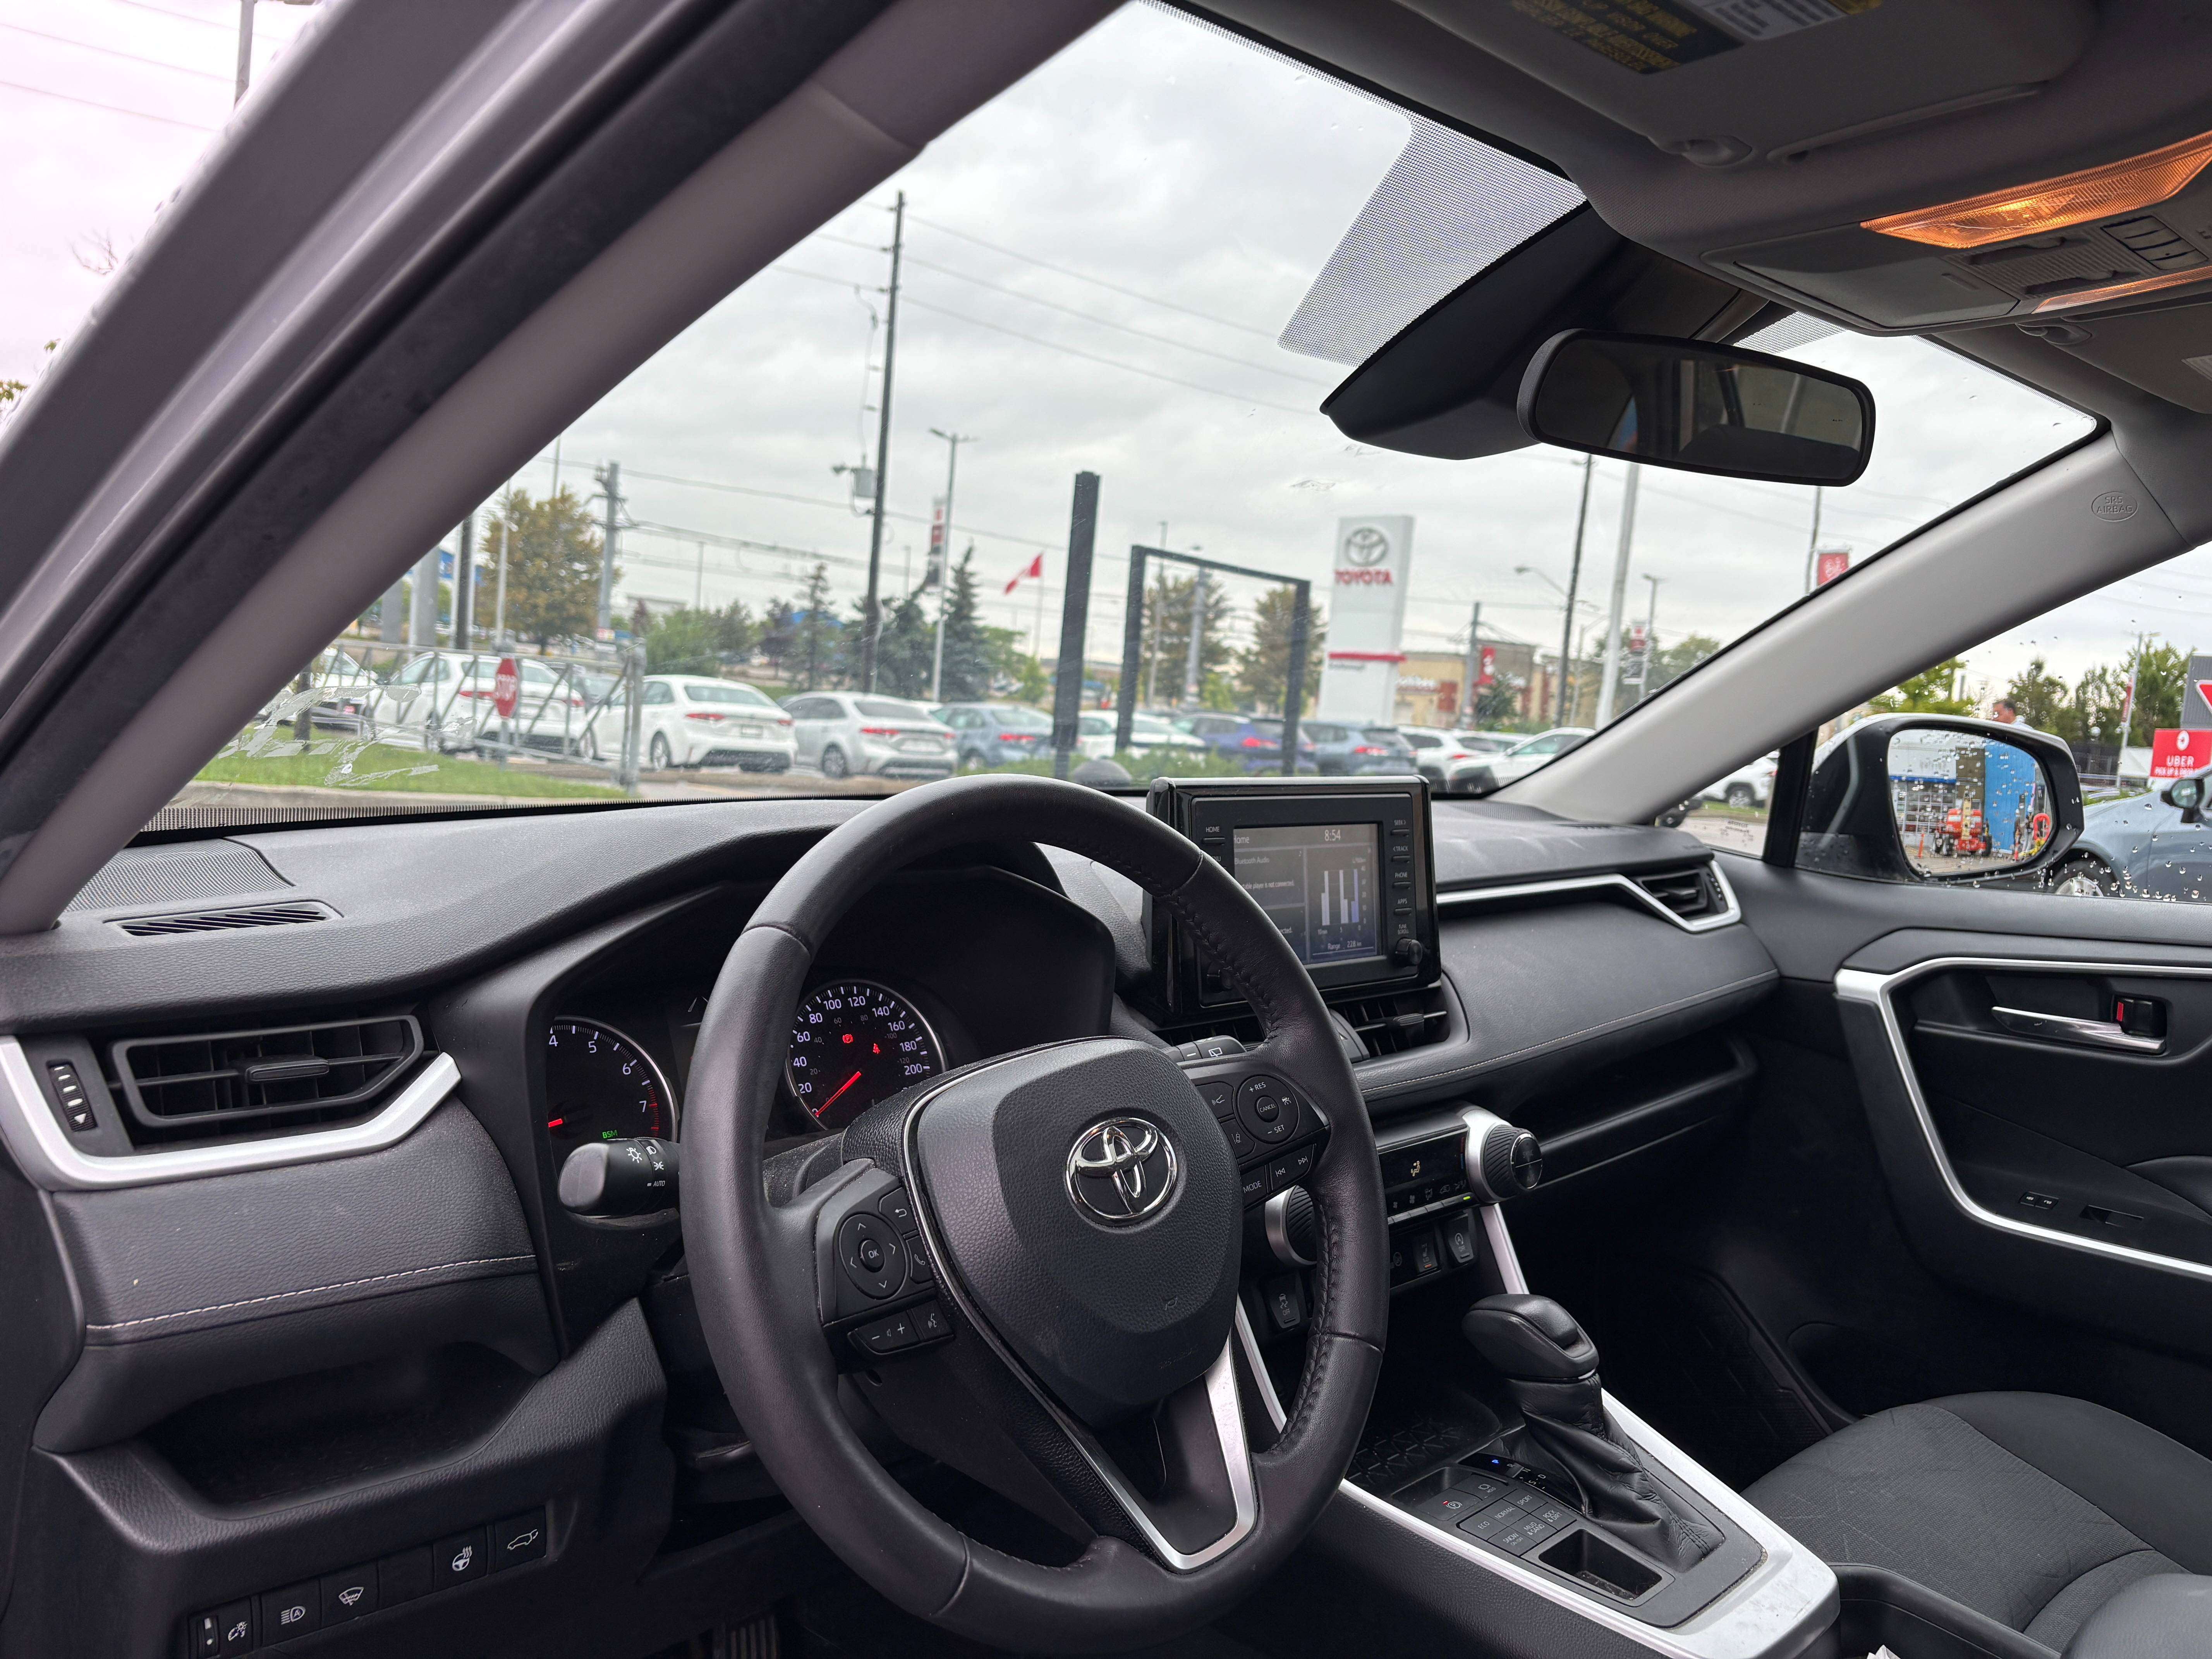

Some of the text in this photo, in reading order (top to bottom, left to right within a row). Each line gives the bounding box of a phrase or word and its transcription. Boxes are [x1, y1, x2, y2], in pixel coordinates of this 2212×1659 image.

[2105, 496, 2123, 504] SRS
[2096, 505, 2133, 514] AIRBAG
[1334, 569, 1393, 584] TOYOTA
[2166, 755, 2194, 767] UBER
[1325, 829, 1341, 842] 8:54
[823, 999, 842, 1010] 100
[848, 996, 866, 1007] 120
[872, 1006, 890, 1017] 140
[809, 1013, 823, 1024] 80
[888, 1020, 905, 1032] 160
[549, 1035, 558, 1047] 4
[797, 1031, 810, 1042] 60
[588, 1041, 597, 1053] 5
[900, 1041, 917, 1052] 180
[793, 1056, 807, 1067] 40
[622, 1063, 631, 1075] 6
[904, 1063, 922, 1075] 200
[798, 1082, 812, 1093] 20
[1254, 1082, 1266, 1090] RES
[639, 1101, 647, 1112] 7
[1259, 1103, 1276, 1113] CANCEL
[1274, 1124, 1285, 1133] SET
[602, 1130, 618, 1139] BSM
[1243, 1180, 1262, 1194] MODE
[868, 1249, 879, 1259] OK
[1517, 1495, 1532, 1505] SPORT
[1494, 1506, 1515, 1519] NORMAL
[1542, 1510, 1555, 1518] ROCK
[1523, 1522, 1537, 1531] MUD
[1530, 1524, 1545, 1533] SAND
[1503, 1532, 1519, 1543] SNOW
